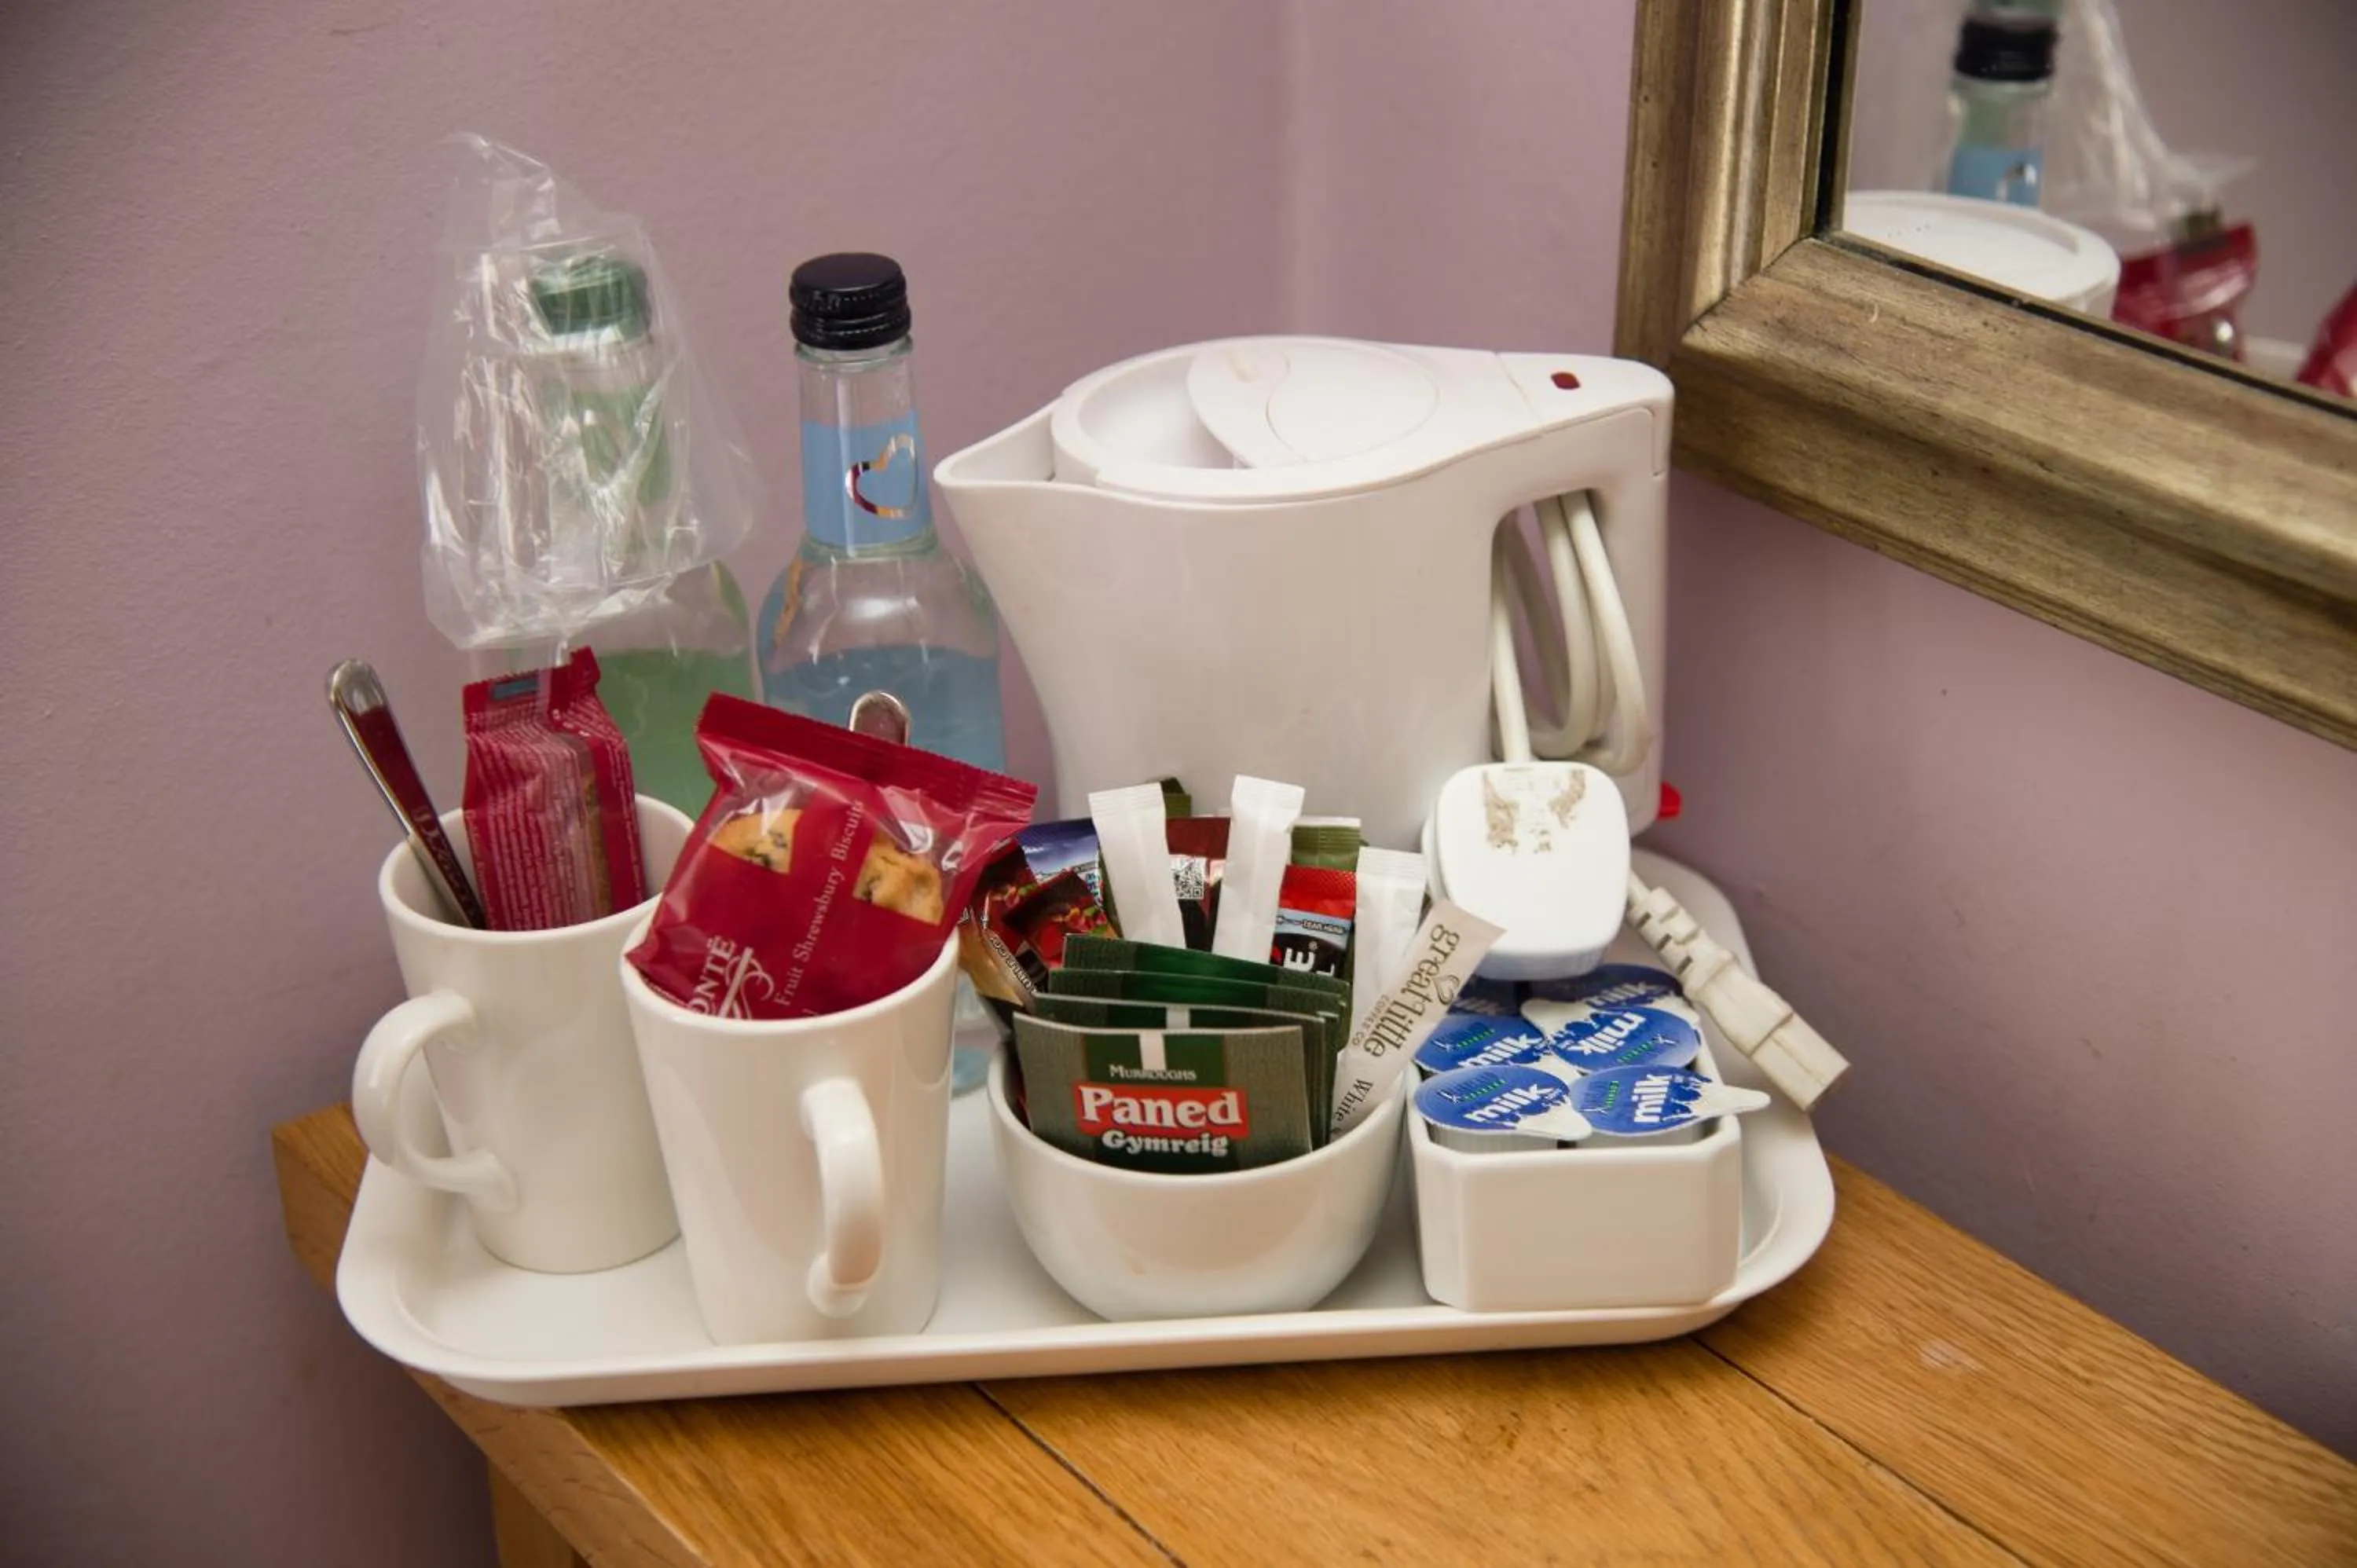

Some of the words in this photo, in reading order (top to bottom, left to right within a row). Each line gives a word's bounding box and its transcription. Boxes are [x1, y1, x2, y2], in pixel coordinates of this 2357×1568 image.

[773, 965, 804, 1006] Fruit
[793, 865, 845, 963] Shrewsbury
[830, 799, 864, 862] Biscuits
[1401, 923, 1461, 1003] great
[1363, 999, 1426, 1058] little
[1458, 1033, 1543, 1068] milk
[1567, 1011, 1647, 1055] milk
[1078, 1085, 1243, 1129] Paned
[1334, 1079, 1374, 1123] White
[1463, 1083, 1555, 1123] milk
[1631, 1074, 1673, 1123] milk
[1101, 1130, 1229, 1158] Gymreig
